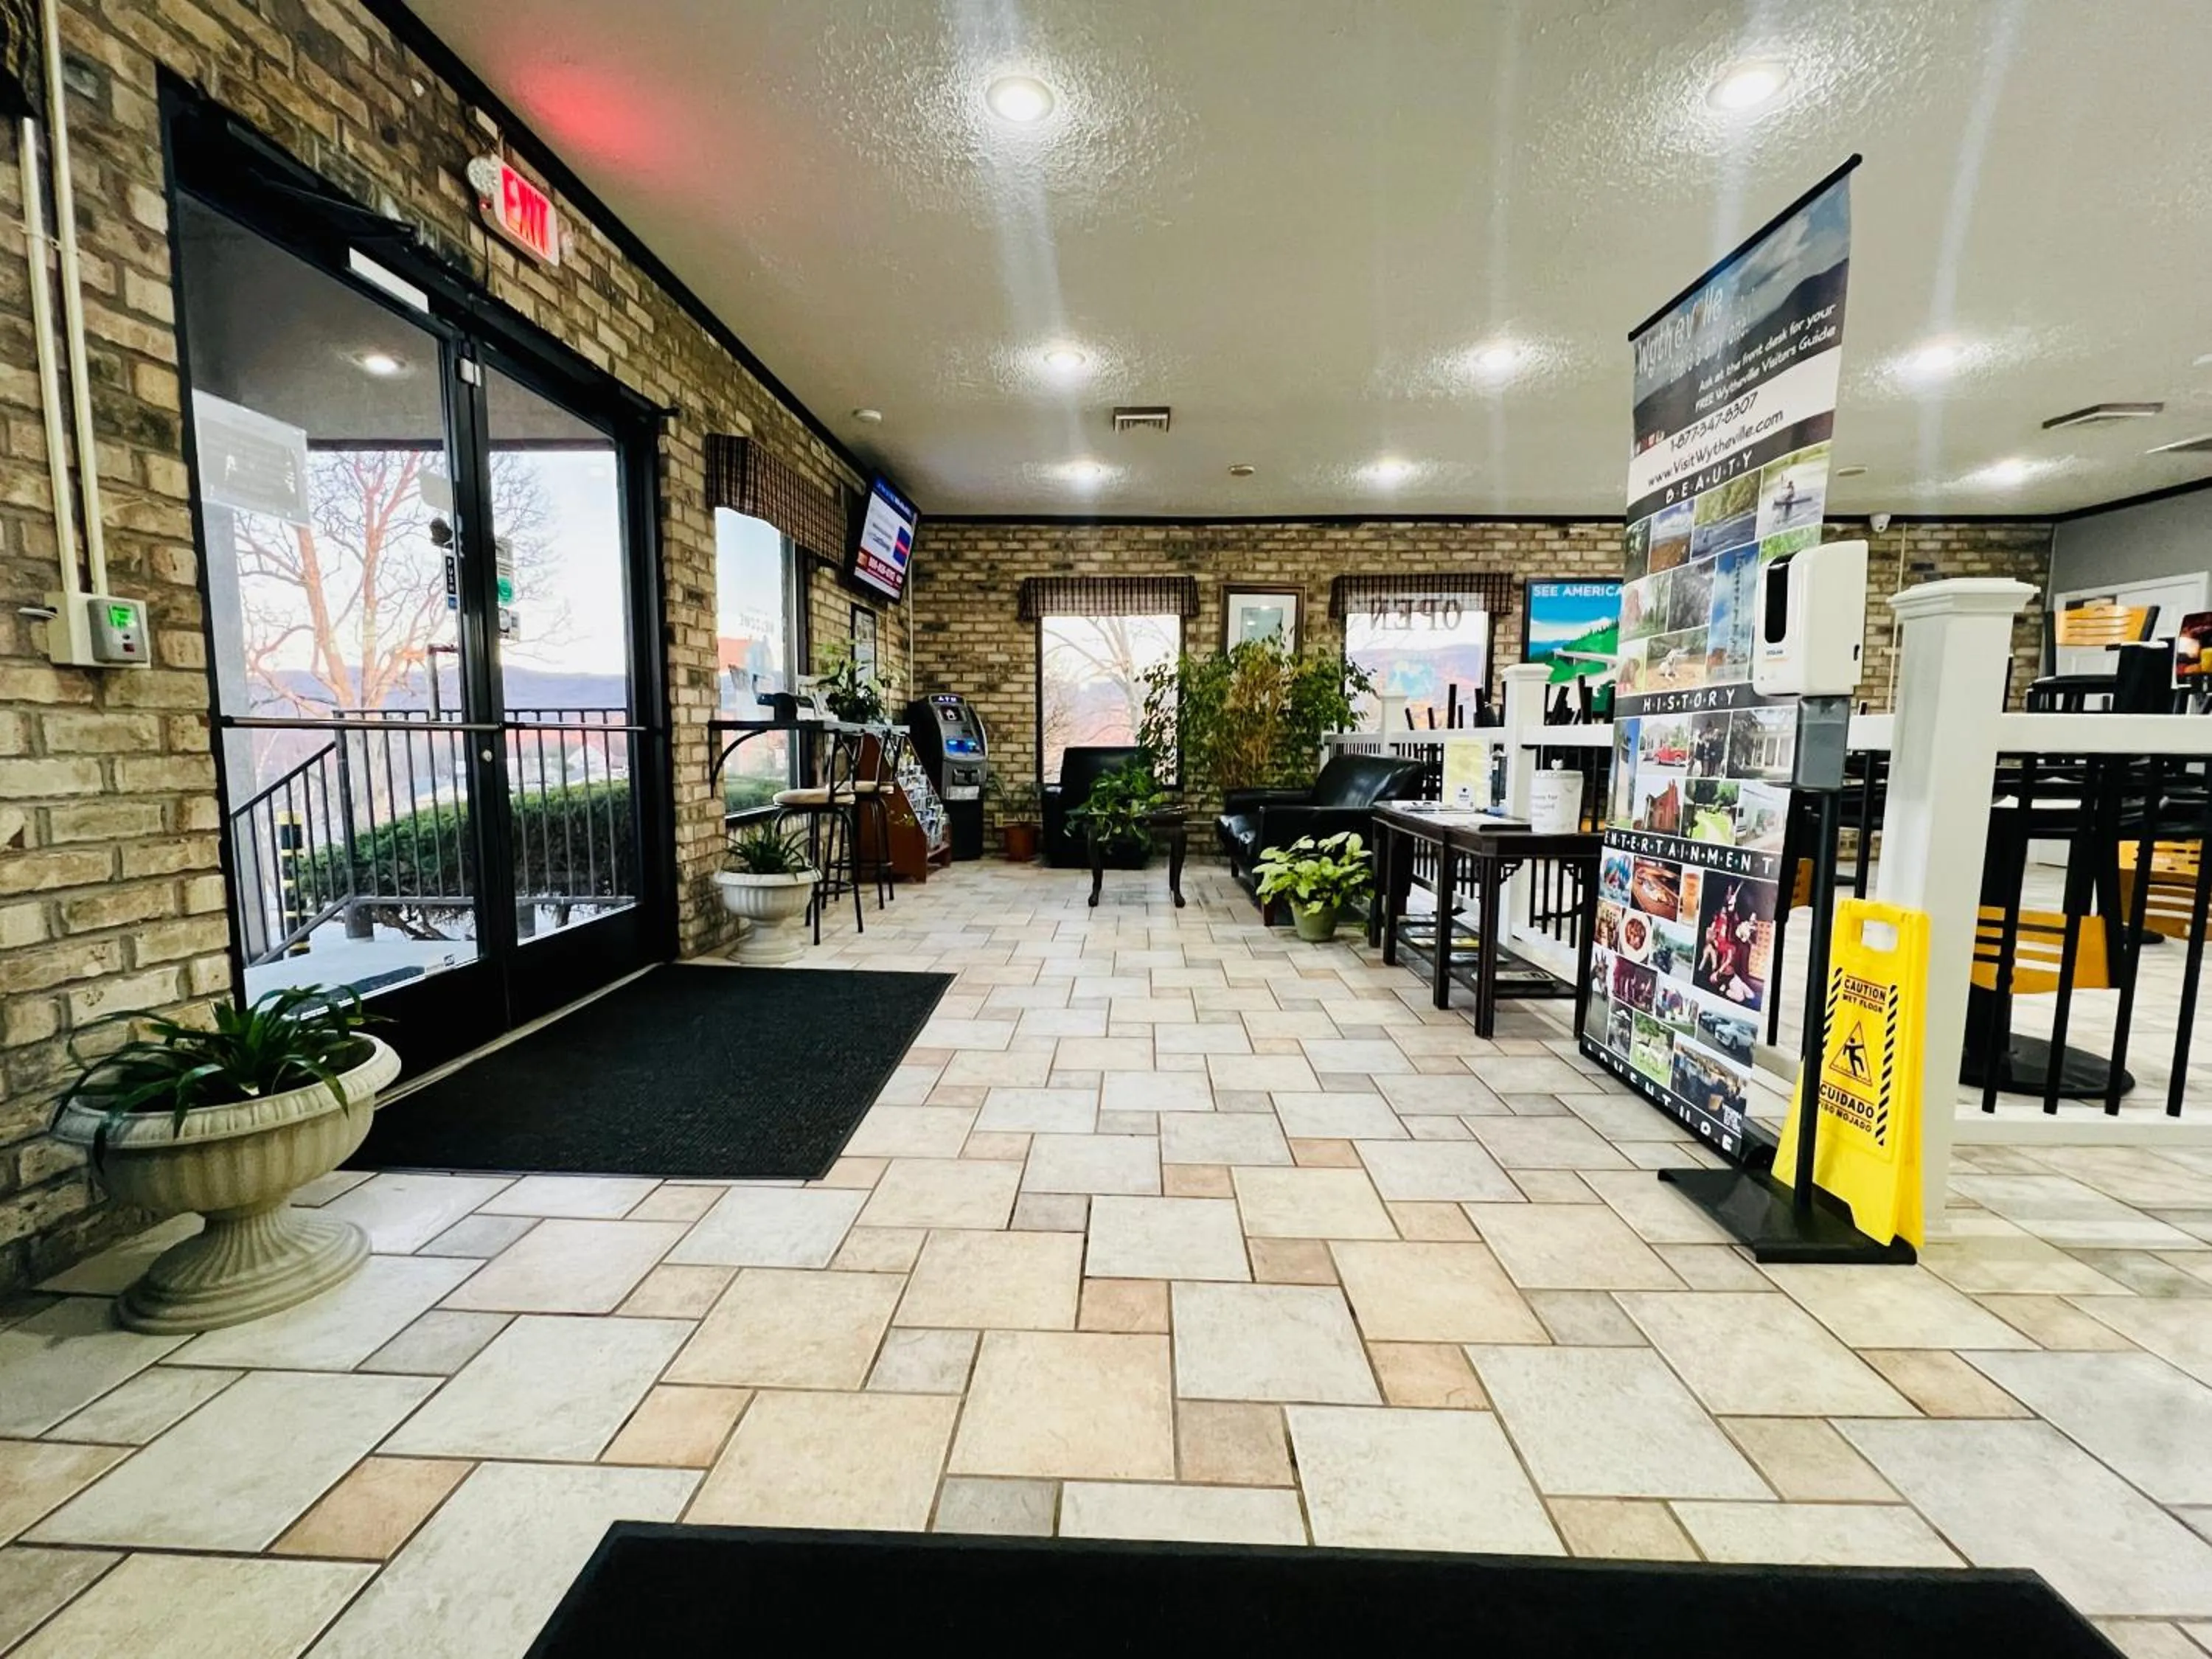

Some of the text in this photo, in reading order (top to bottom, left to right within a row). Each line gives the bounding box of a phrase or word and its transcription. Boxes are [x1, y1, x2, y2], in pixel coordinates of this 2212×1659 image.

[1638, 286, 1723, 378] Wythevlle
[1764, 327, 1788, 351] desk
[1790, 320, 1806, 335] for
[1806, 303, 1836, 329] your
[1799, 325, 1836, 350] Guide
[1648, 410, 1784, 487] www.VisitWytheville.com
[1533, 585, 1557, 597] SEE
[1843, 994, 1882, 1013] WET FLOOR
[1844, 978, 1887, 1001] CAUTION
[1820, 1083, 1874, 1119] CUIDADO
[1820, 1102, 1871, 1133] ISO MOJADO
